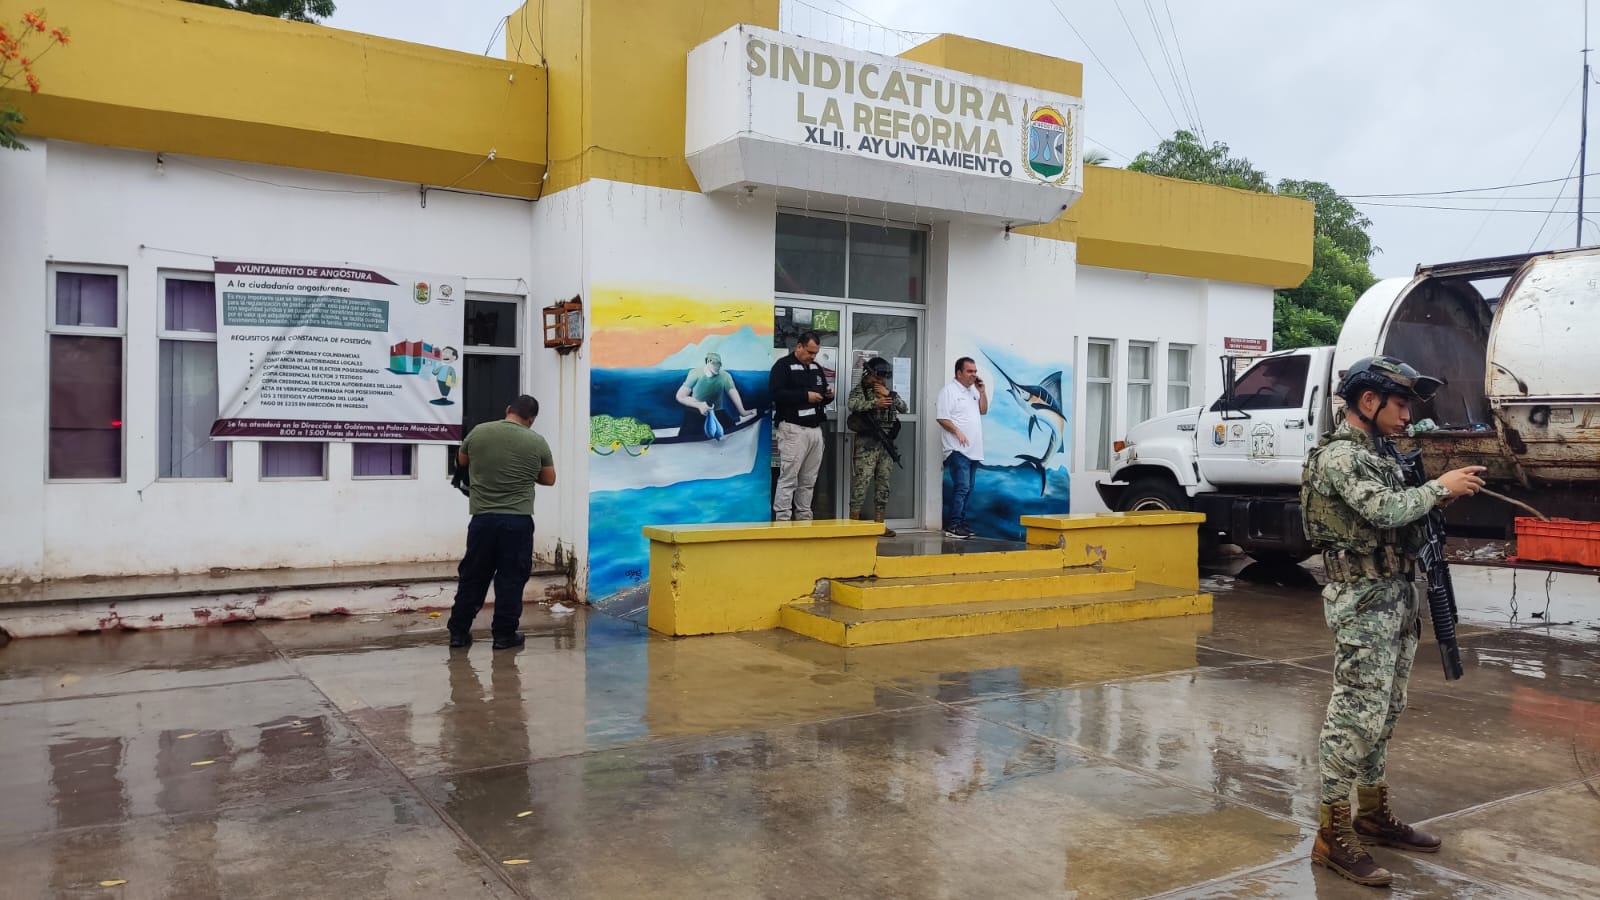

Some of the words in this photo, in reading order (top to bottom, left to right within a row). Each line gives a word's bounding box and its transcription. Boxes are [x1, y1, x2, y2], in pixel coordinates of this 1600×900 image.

[746, 39, 1013, 125] SINDICATURA
[797, 91, 844, 130] LA
[853, 102, 1003, 157] REFORMA
[858, 136, 1012, 176] AYUNTAMIENTO
[235, 265, 304, 276] AYUNTAMIENTO
[307, 268, 318, 276] DE
[320, 270, 372, 280] ANGOSTURA
[249, 281, 294, 290] ciudadanía
[297, 284, 350, 293] angosturense:
[410, 425, 439, 433] Municipal
